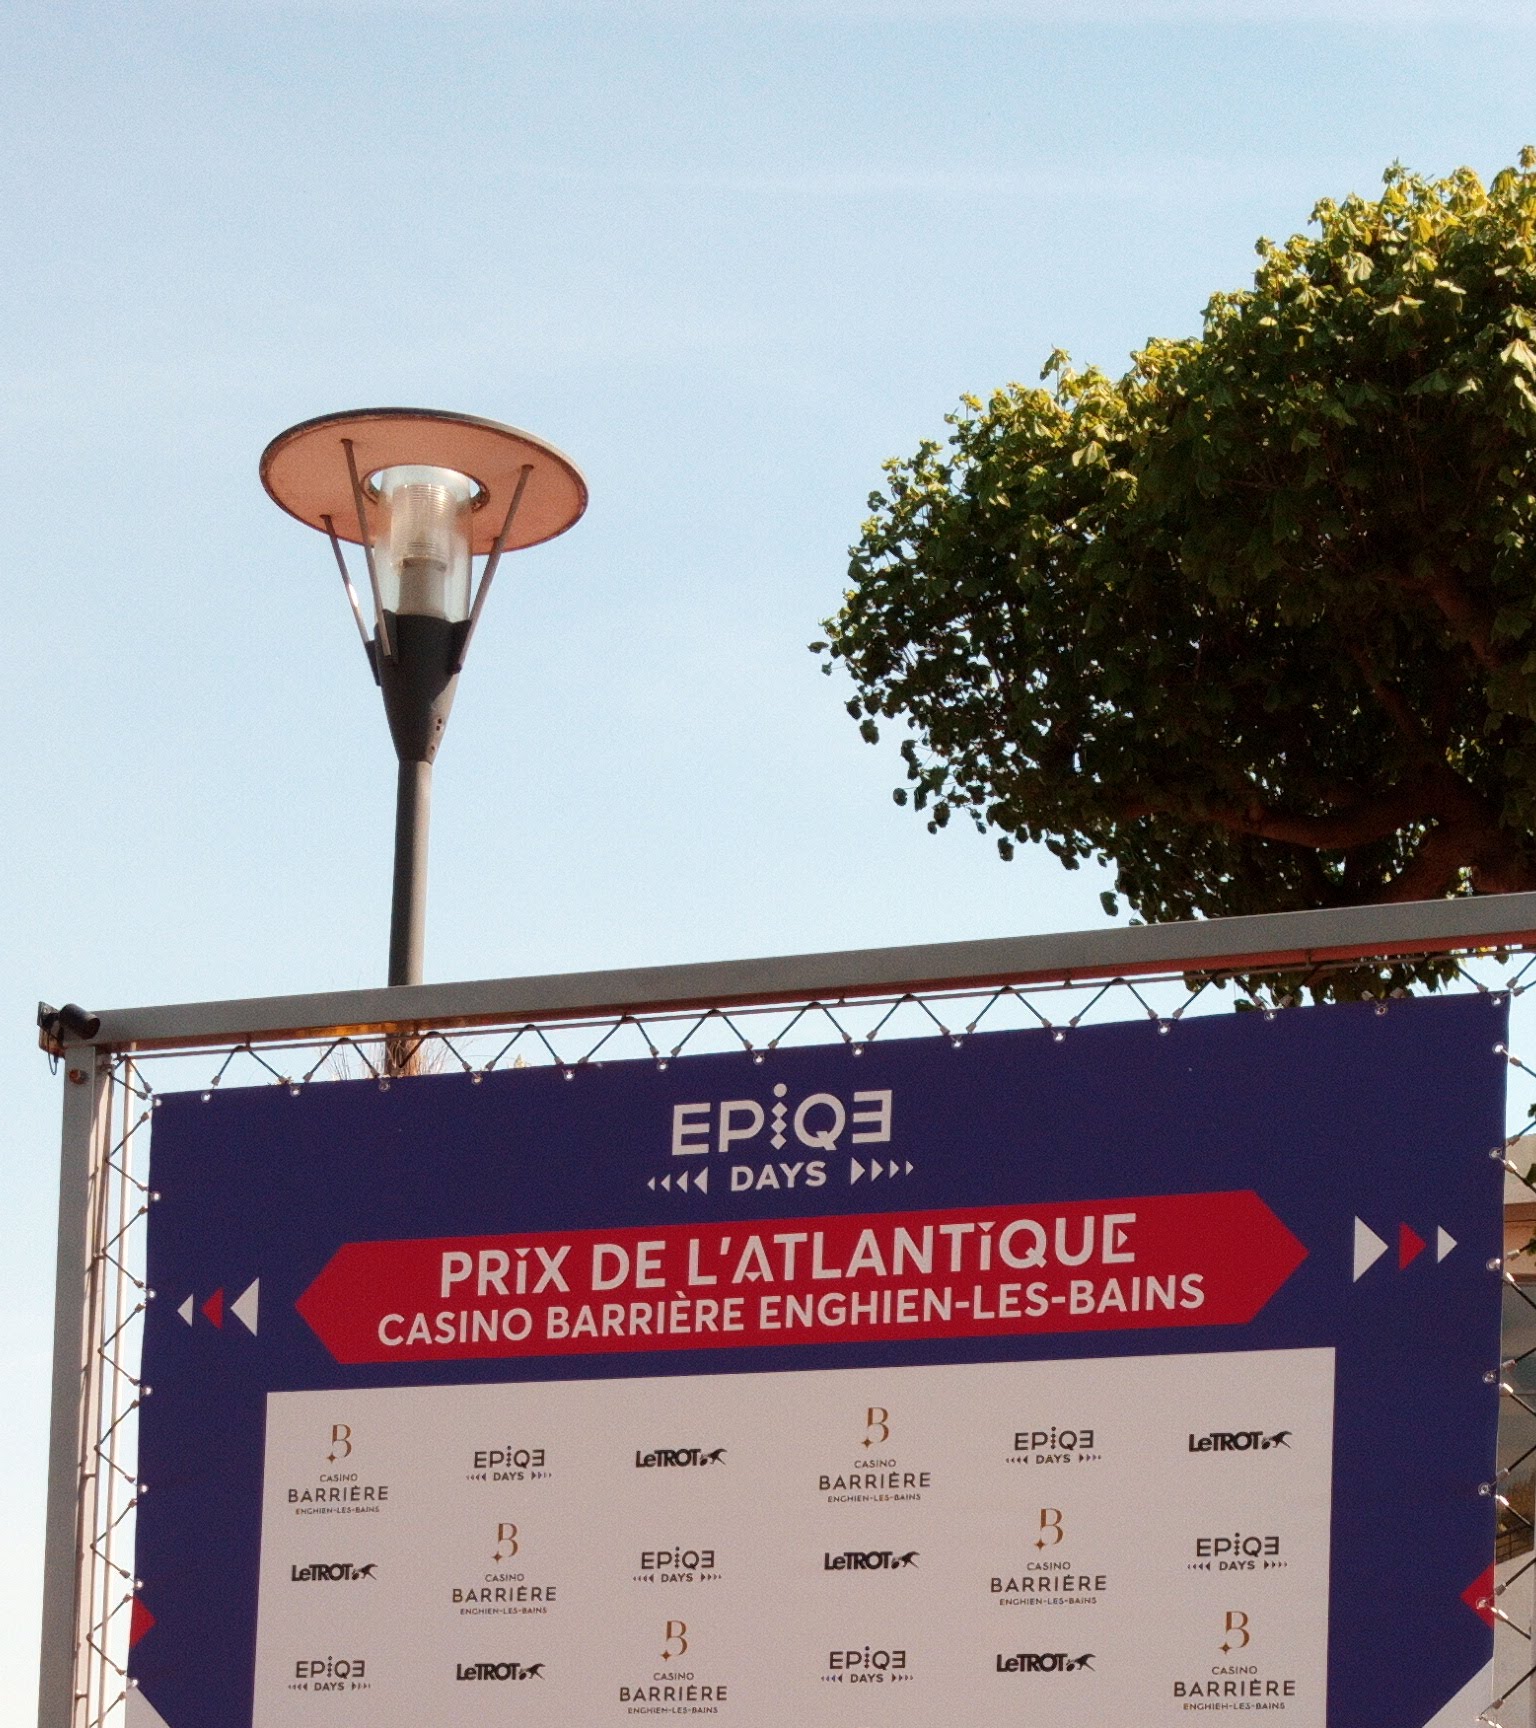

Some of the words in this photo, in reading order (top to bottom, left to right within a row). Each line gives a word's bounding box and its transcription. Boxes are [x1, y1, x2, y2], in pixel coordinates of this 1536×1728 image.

[731, 1161, 826, 1191] DAYS
[592, 1241, 665, 1290] DE
[378, 1308, 532, 1345] CASINO
[547, 1291, 744, 1338] BARRIÈRE
[760, 1274, 1204, 1329] ENGHIEN-LES-BAINS
[854, 1459, 896, 1468] CASINO
[1036, 1454, 1070, 1464] DAYS
[320, 1473, 357, 1482] CASINO
[493, 1472, 524, 1481] DAYS
[819, 1472, 930, 1490] BARRIÈRE
[288, 1486, 388, 1503] BARRIÈRE
[1027, 1562, 1070, 1571] CASINO
[1219, 1561, 1255, 1571] DAYS
[485, 1573, 524, 1582] CASINO
[661, 1573, 693, 1582] DAYS
[991, 1575, 1106, 1593] BARRIÈRE
[452, 1586, 556, 1603] BARRIÈRE
[1212, 1666, 1257, 1675] CASINO
[654, 1672, 694, 1681] CASINO
[850, 1674, 883, 1684] DAYS
[314, 1682, 344, 1691] DAYS
[1174, 1679, 1295, 1697] BARRIÈRE
[620, 1685, 726, 1702] BARRIÈRE
